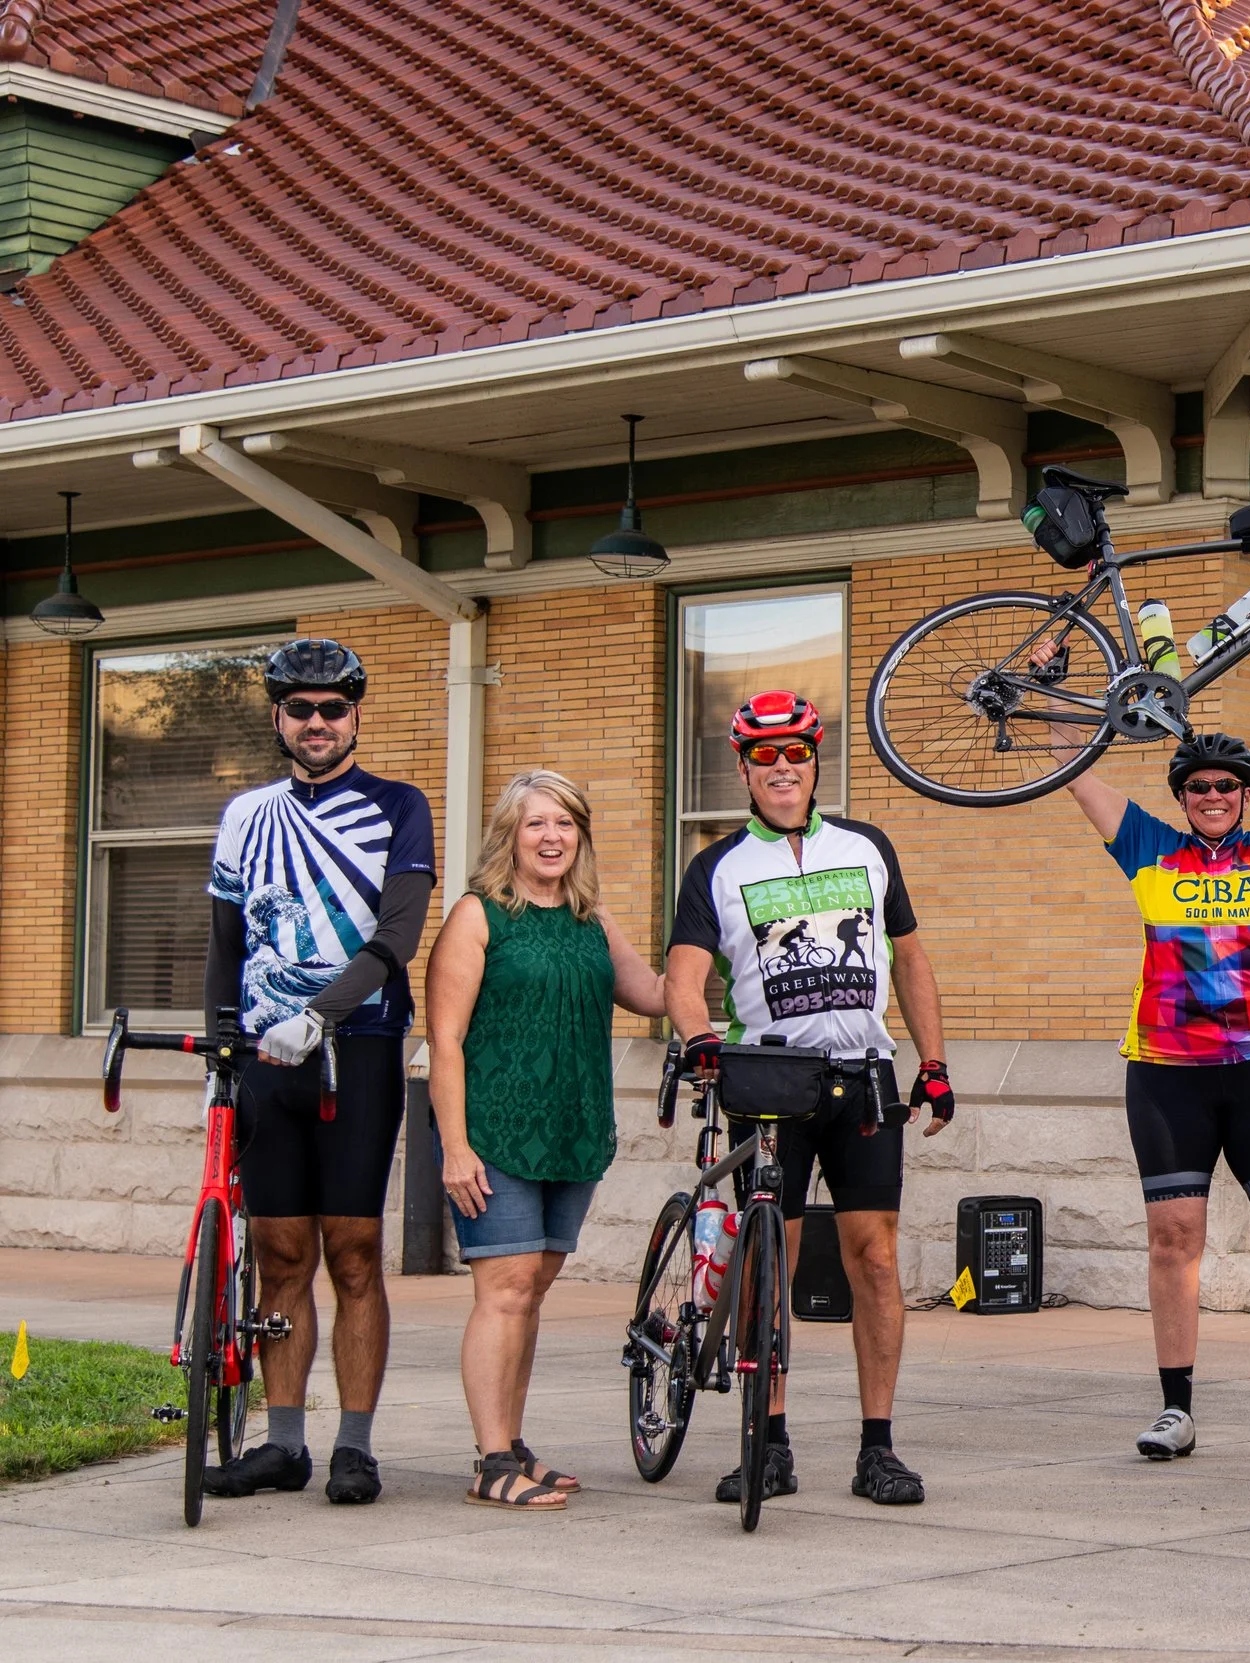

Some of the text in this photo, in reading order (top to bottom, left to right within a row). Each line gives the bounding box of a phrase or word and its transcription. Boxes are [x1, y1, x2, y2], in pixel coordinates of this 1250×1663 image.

[787, 870, 864, 886] CELEBRATING
[746, 878, 867, 908] 25 YEARS
[754, 893, 869, 919] CARDINAL
[1185, 907, 1250, 918] 500 IN MAY
[769, 973, 875, 995] GREENWAYS
[771, 988, 875, 1017] 1993-2018
[211, 1112, 223, 1180] ORBEA
